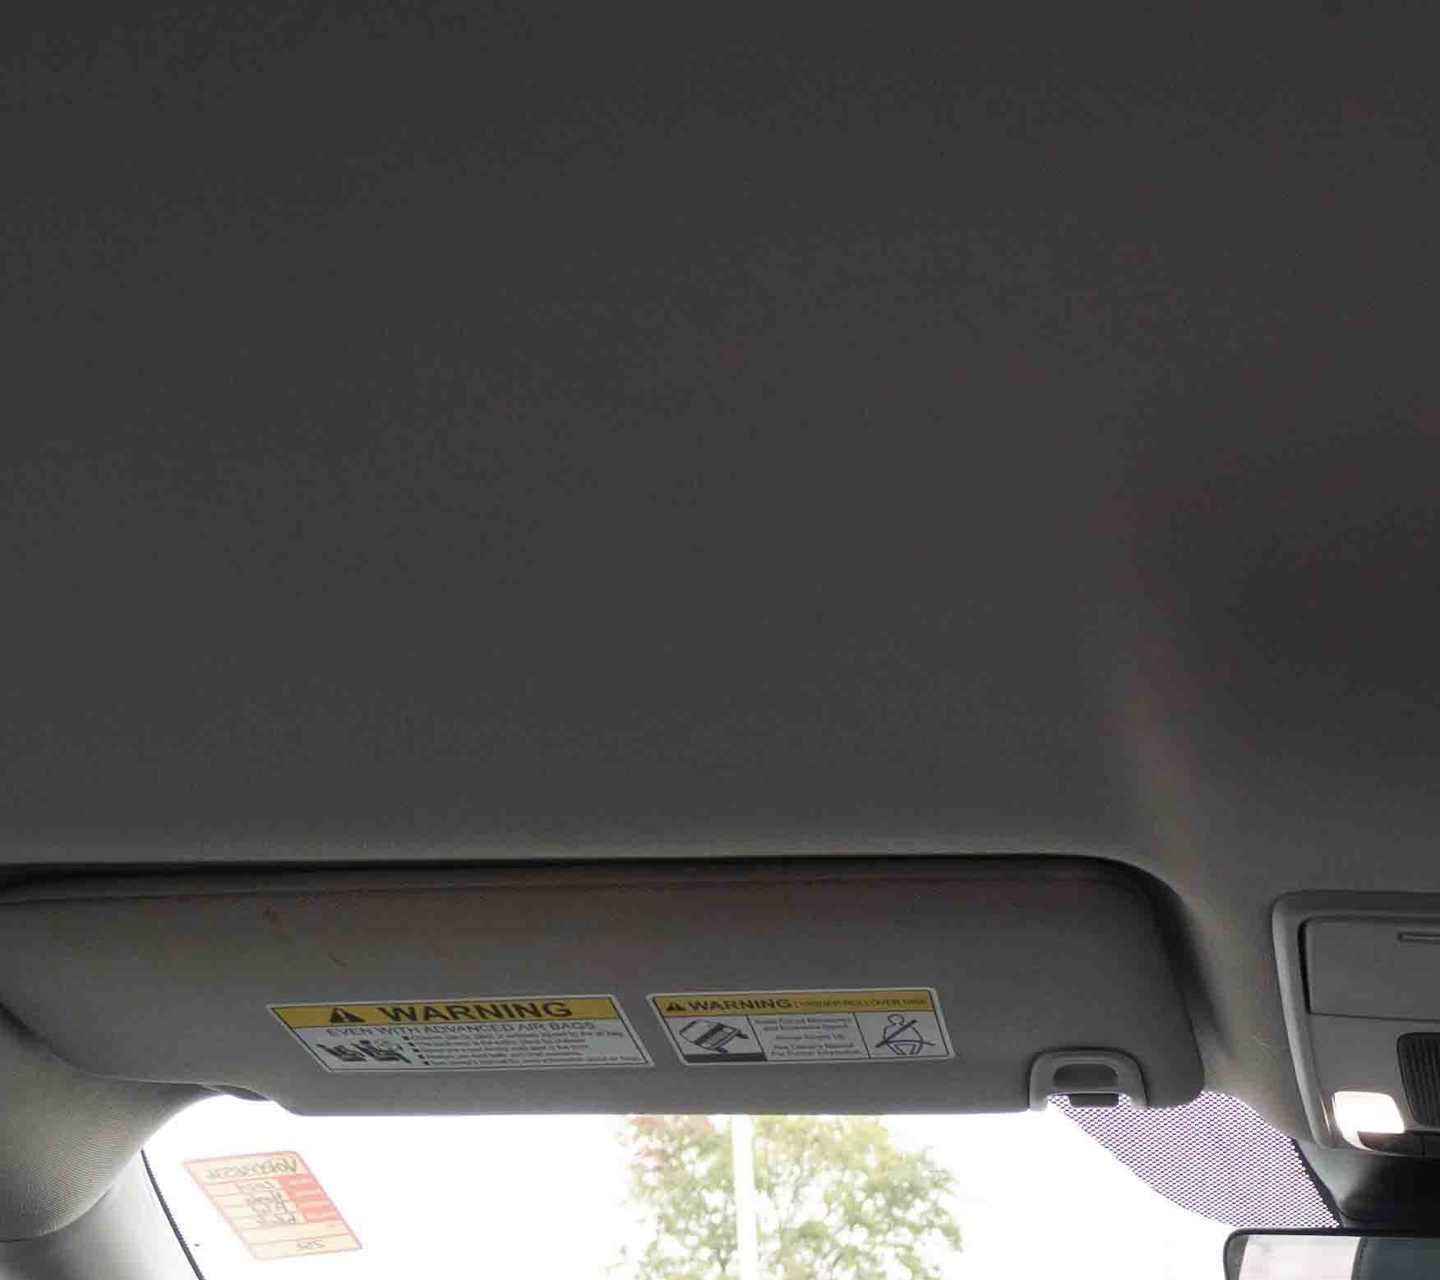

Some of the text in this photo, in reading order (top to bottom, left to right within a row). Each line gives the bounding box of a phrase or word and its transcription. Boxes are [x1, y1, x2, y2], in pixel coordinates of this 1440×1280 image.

[378, 1001, 574, 1023] WARNING
[326, 1026, 371, 1038] EVEN
[374, 1025, 412, 1037] WITH
[415, 1023, 516, 1035] ADVANCED
[519, 1022, 547, 1032] AIR
